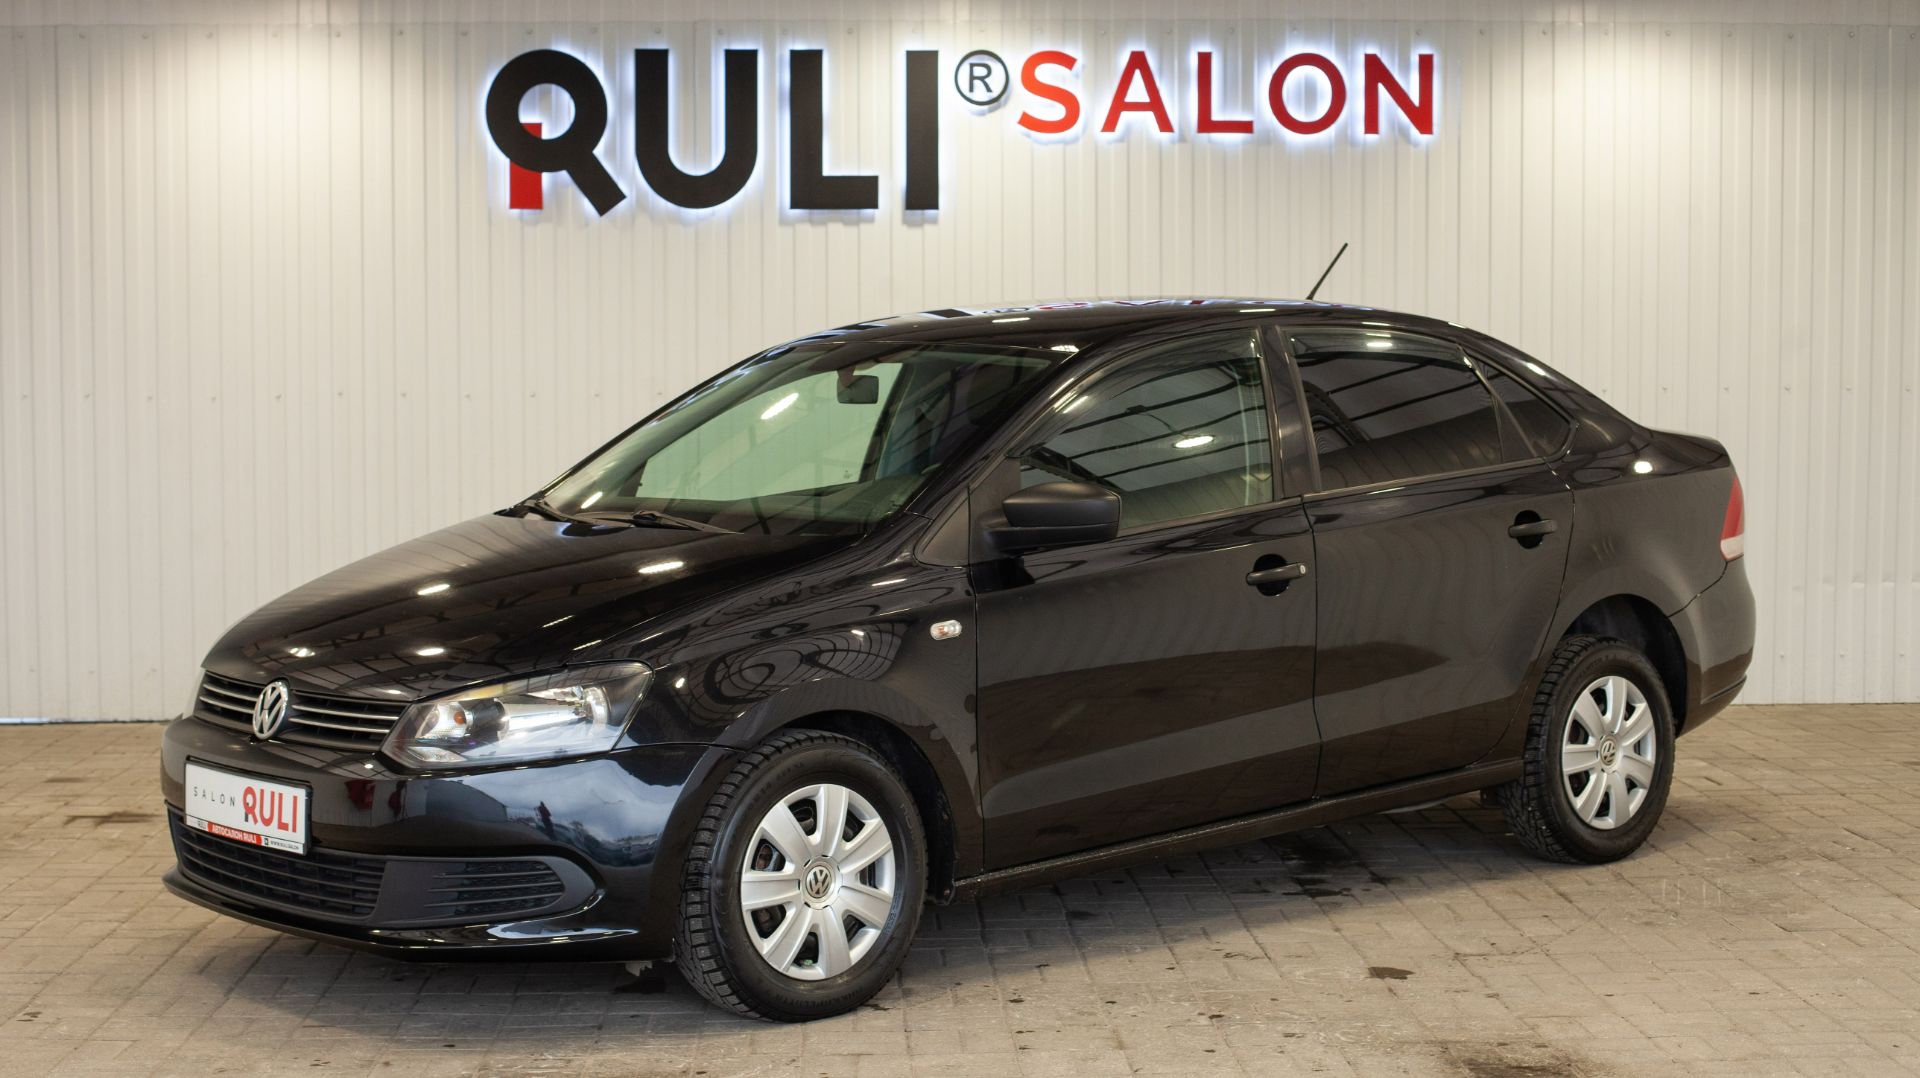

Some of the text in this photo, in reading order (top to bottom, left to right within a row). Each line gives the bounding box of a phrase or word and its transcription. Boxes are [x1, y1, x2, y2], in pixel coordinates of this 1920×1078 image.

[1017, 50, 1435, 135] SALON
[194, 786, 298, 833] SALON RULI
